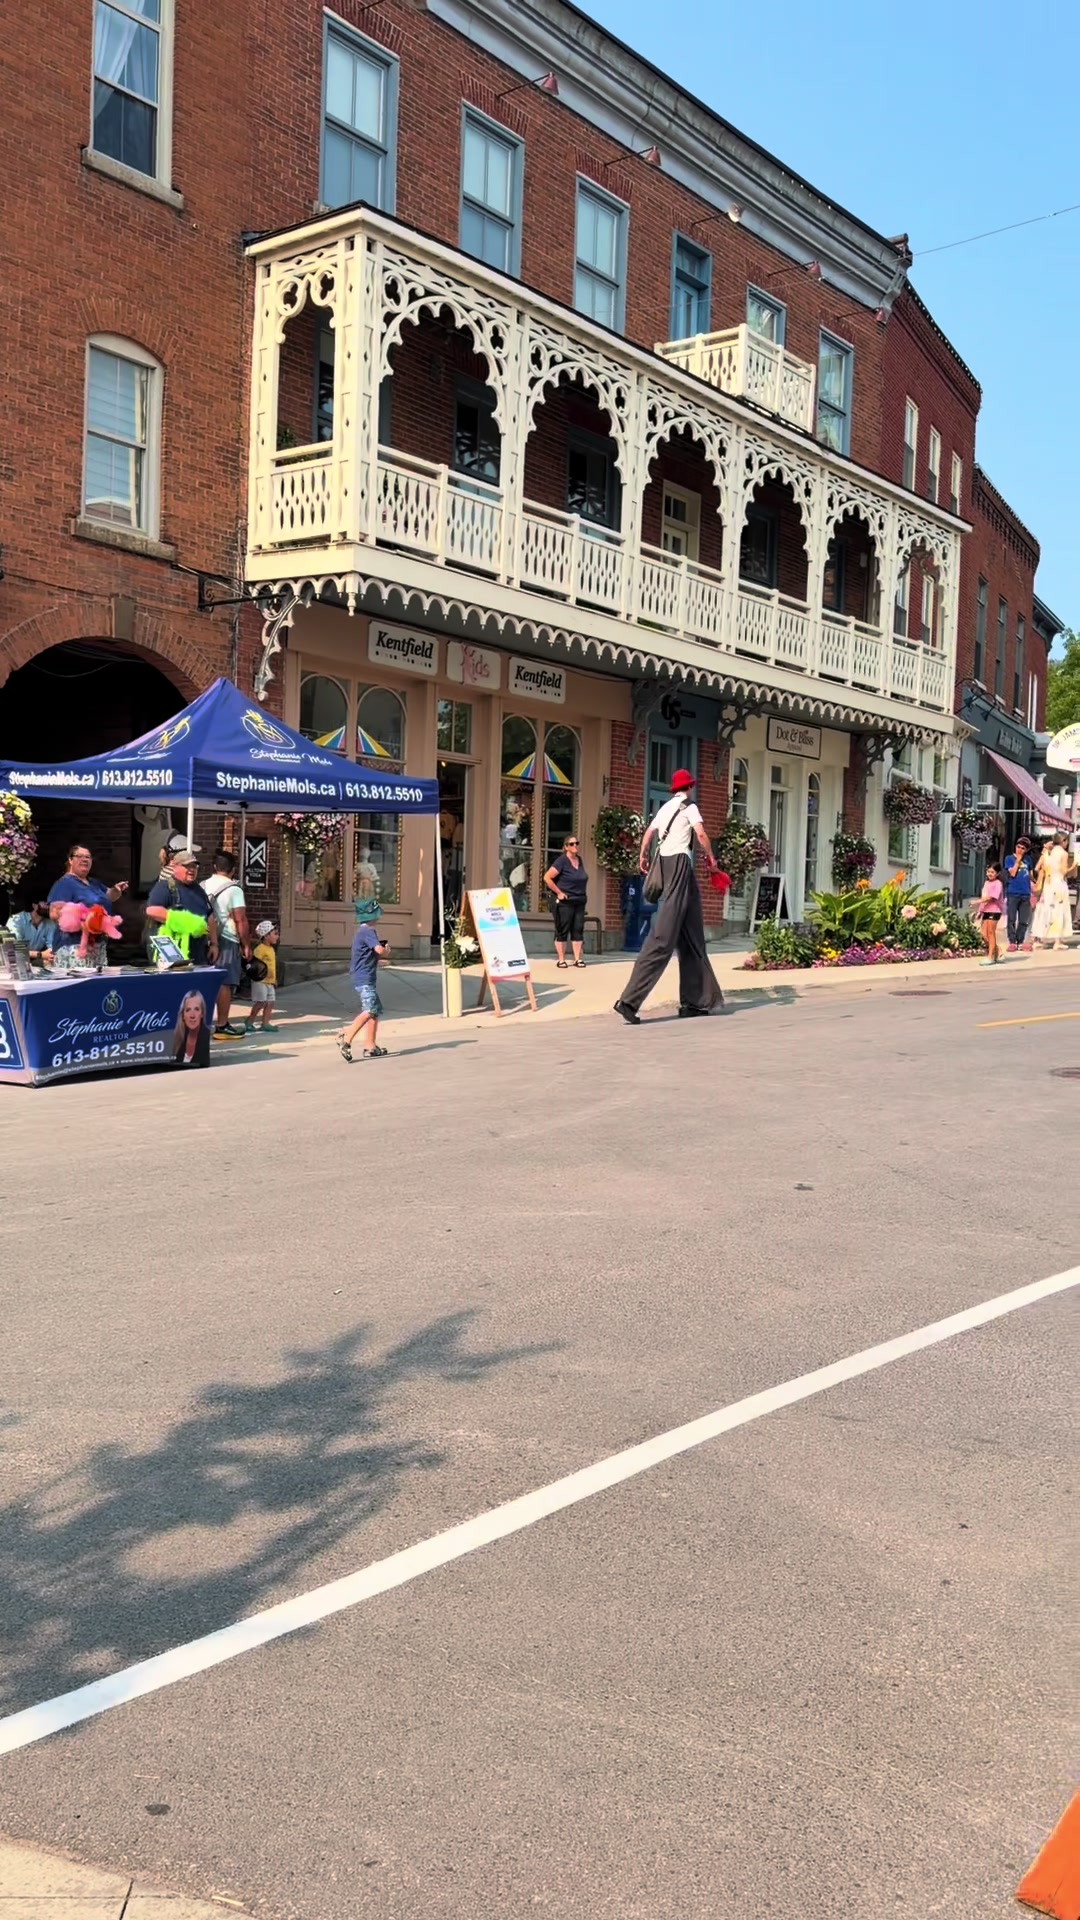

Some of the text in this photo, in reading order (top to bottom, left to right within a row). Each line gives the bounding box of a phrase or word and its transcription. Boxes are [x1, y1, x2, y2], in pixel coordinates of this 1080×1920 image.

[375, 630, 434, 659] Kentfield
[460, 642, 490, 686] Kids
[515, 664, 562, 690] Kentfield
[661, 694, 682, 730] 65
[8, 770, 94, 789] StephanieMols.ca
[101, 768, 173, 787] 613.812.5510
[216, 771, 336, 796] StephanieMols.ca
[345, 782, 423, 802] 613.812.5510
[48, 1010, 171, 1045] Stephanie Mols
[92, 1032, 129, 1043] REALTOR
[52, 1040, 165, 1068] 613-812-5510
